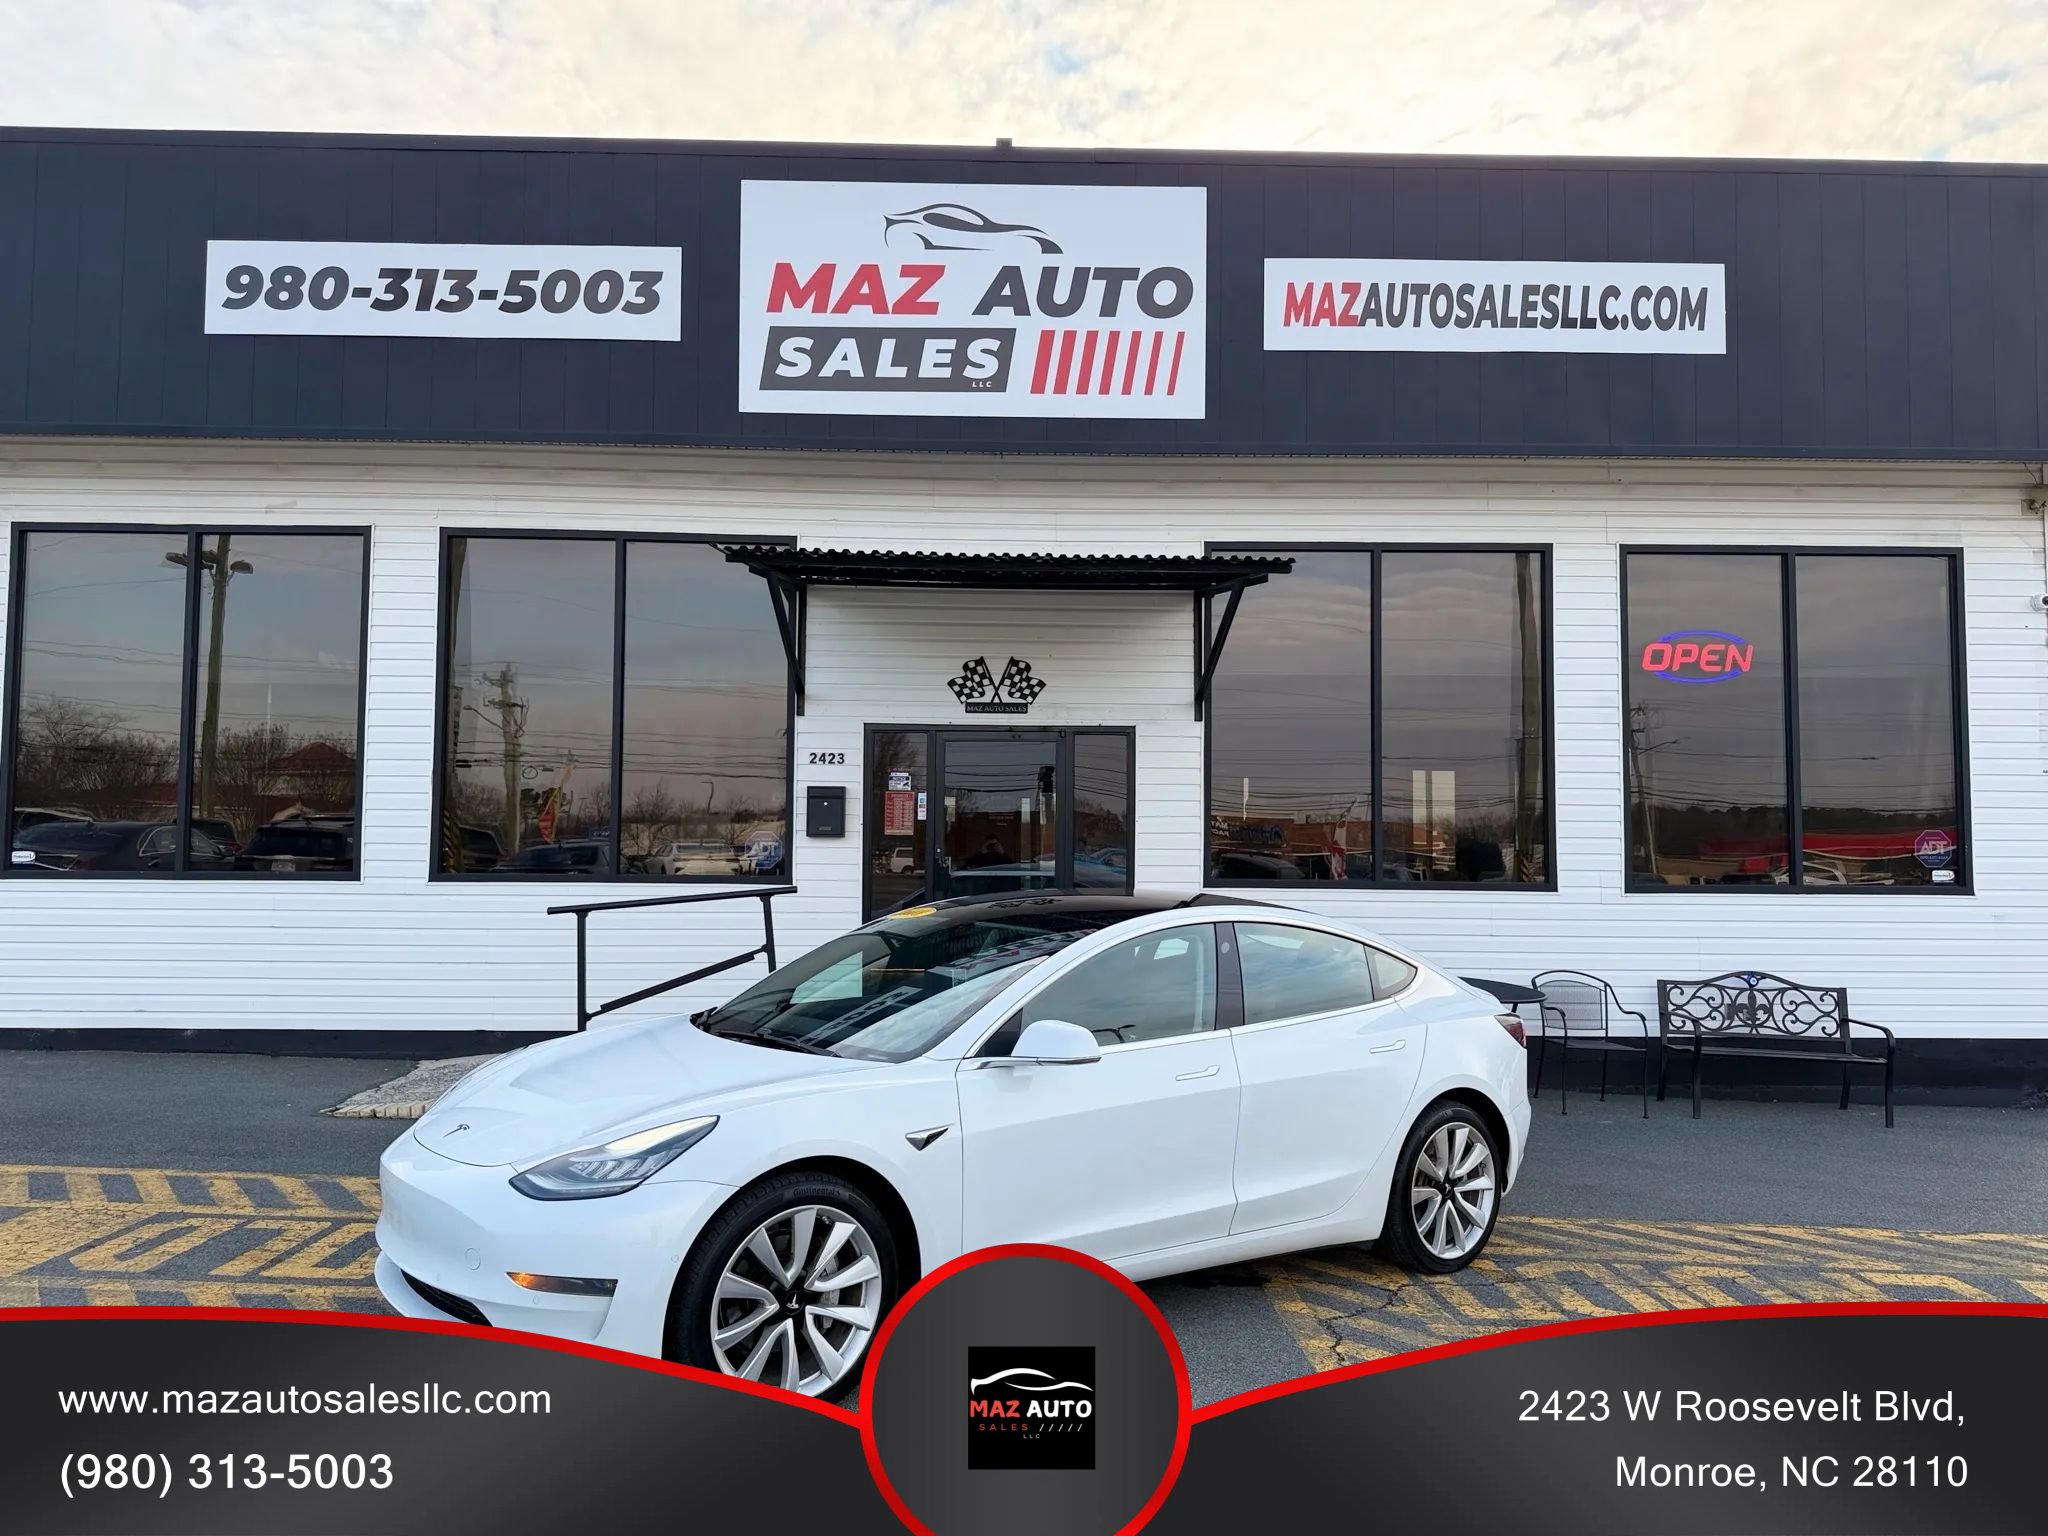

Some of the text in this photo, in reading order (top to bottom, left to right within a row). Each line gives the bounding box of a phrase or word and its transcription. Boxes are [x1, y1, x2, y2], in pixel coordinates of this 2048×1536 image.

[221, 264, 665, 315] 980-313-5003
[766, 262, 1195, 319] MAZ AUTO
[1283, 281, 1708, 331] MAZAUTOSALESLLC.COM
[774, 336, 1001, 379] SALES
[1641, 642, 1754, 673] OPEN
[809, 752, 845, 765] 2423
[751, 841, 779, 857] ADT
[1920, 840, 1949, 855] ADT
